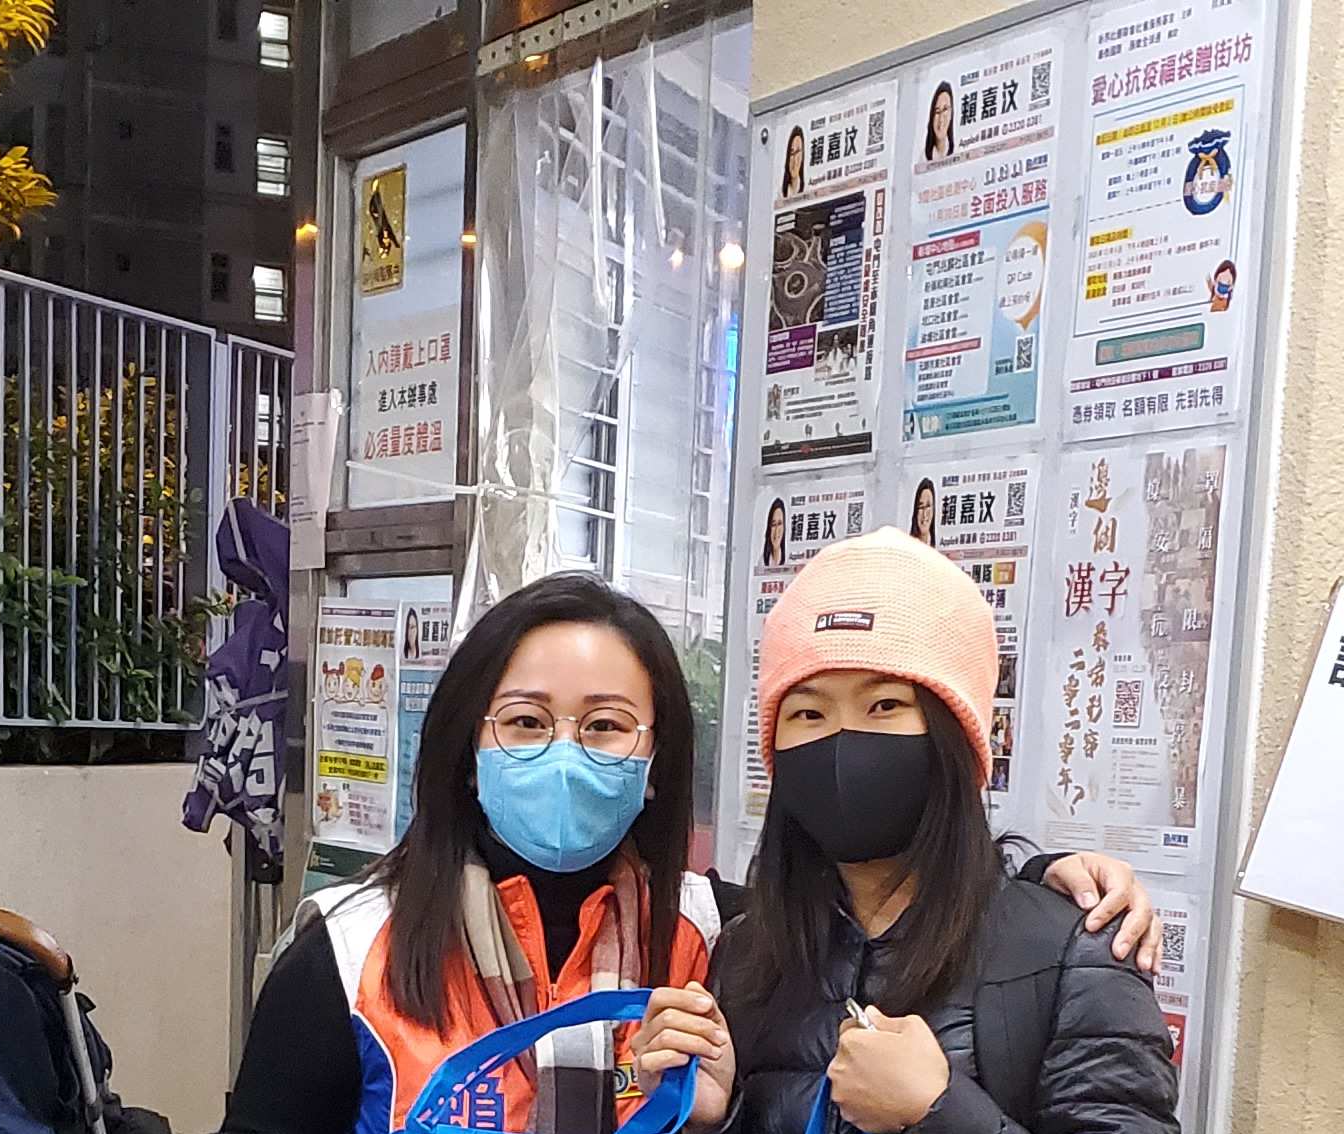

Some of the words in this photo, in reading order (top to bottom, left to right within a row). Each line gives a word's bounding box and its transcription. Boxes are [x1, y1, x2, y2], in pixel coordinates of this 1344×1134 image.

[1091, 33, 1253, 106] 愛心抗疫福袋贈街坊
[959, 79, 1019, 127] 賴嘉汶
[809, 125, 859, 166] 賴嘉汶
[970, 178, 1048, 219] 全面投入服務
[366, 332, 452, 377] 入內請戴上口罩
[377, 380, 438, 412] 進入本辦事處
[1122, 393, 1169, 418] 名額有限
[1175, 385, 1224, 411] 先到先得
[363, 419, 443, 460] 必須量度體溫
[790, 510, 837, 542] 賴嘉汶
[941, 491, 995, 526] 賴嘉汶
[1065, 561, 1130, 617] 漢字
